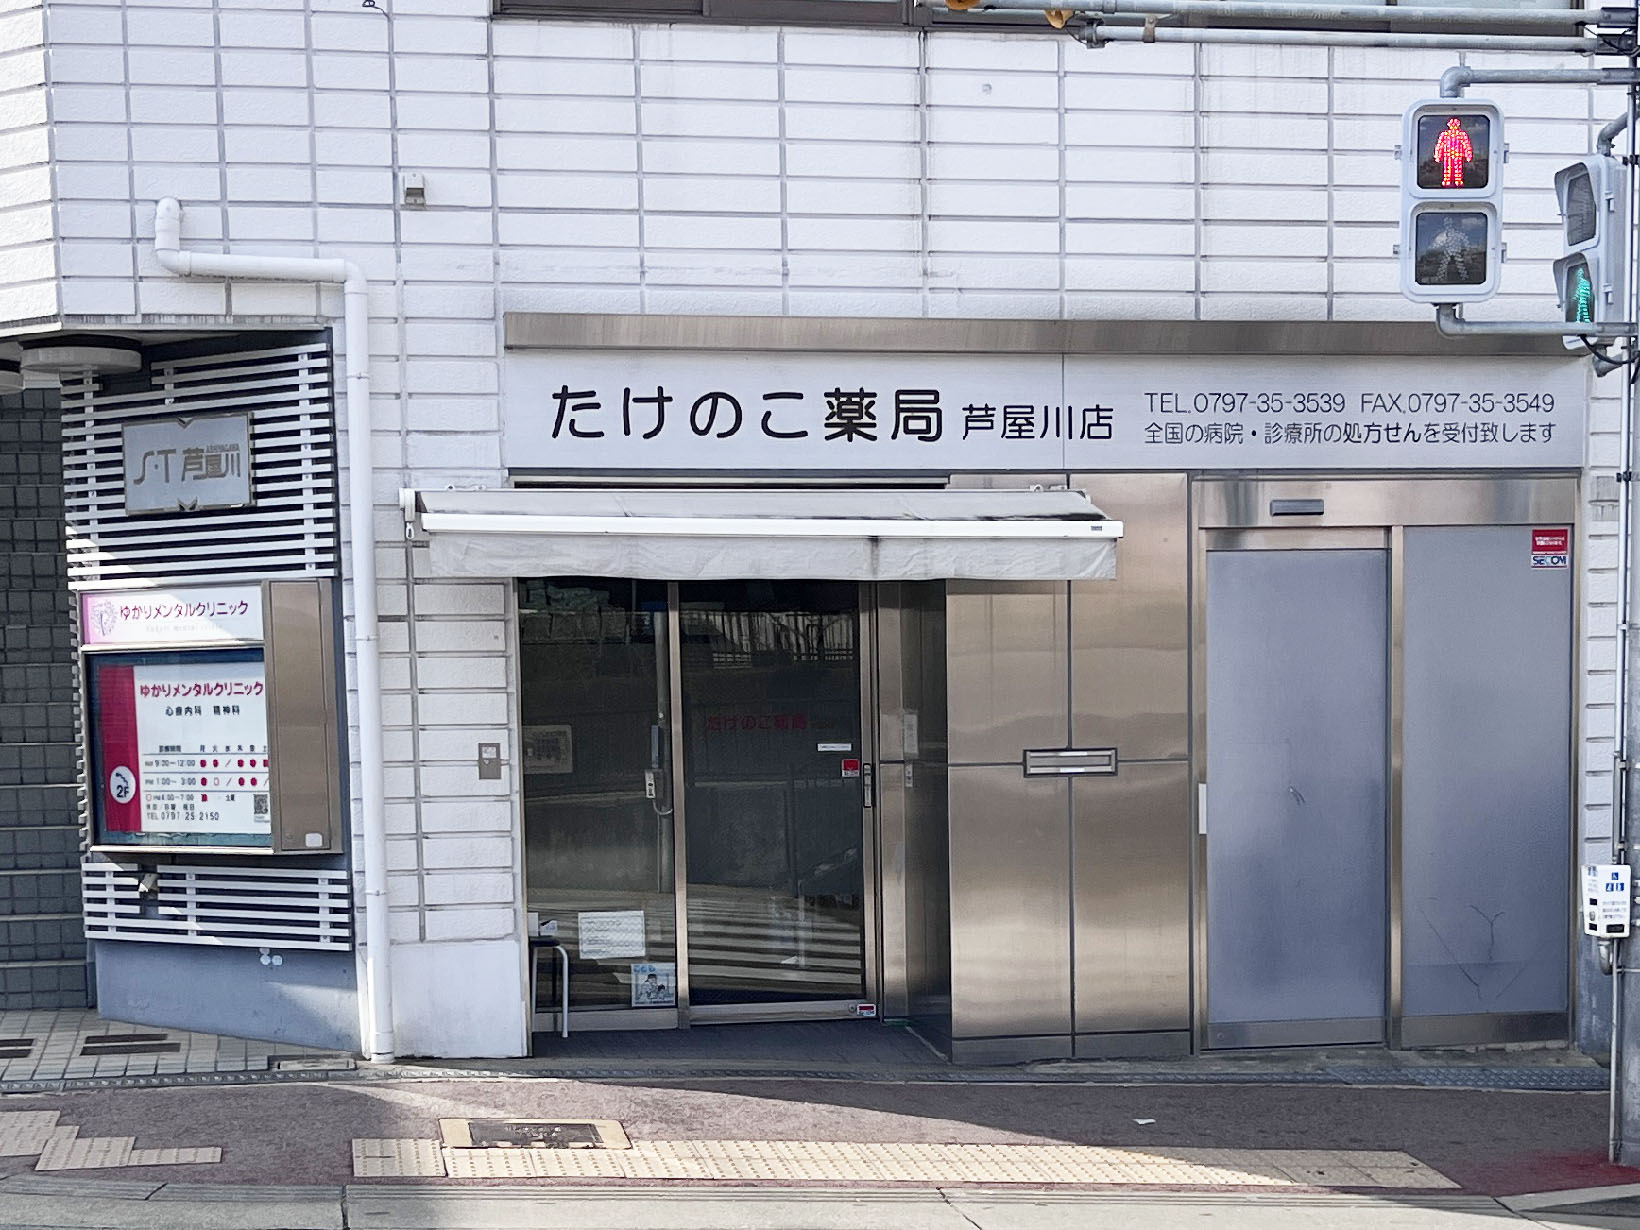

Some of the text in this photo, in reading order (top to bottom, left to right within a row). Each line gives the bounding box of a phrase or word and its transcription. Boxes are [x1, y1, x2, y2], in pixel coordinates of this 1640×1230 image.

[1144, 392, 1555, 414] TEL.0797-35-3539 FAX.0797-35-3549
[552, 385, 1114, 443] たけのこ薬局 芦屋川店
[1144, 421, 1557, 445] 全国の病院・診療所の処方せんを受付致します
[120, 600, 249, 620] ゆかりメンタルクリニック
[140, 681, 264, 698] ゆかりメンタルクリニック
[116, 785, 129, 797] 2F
